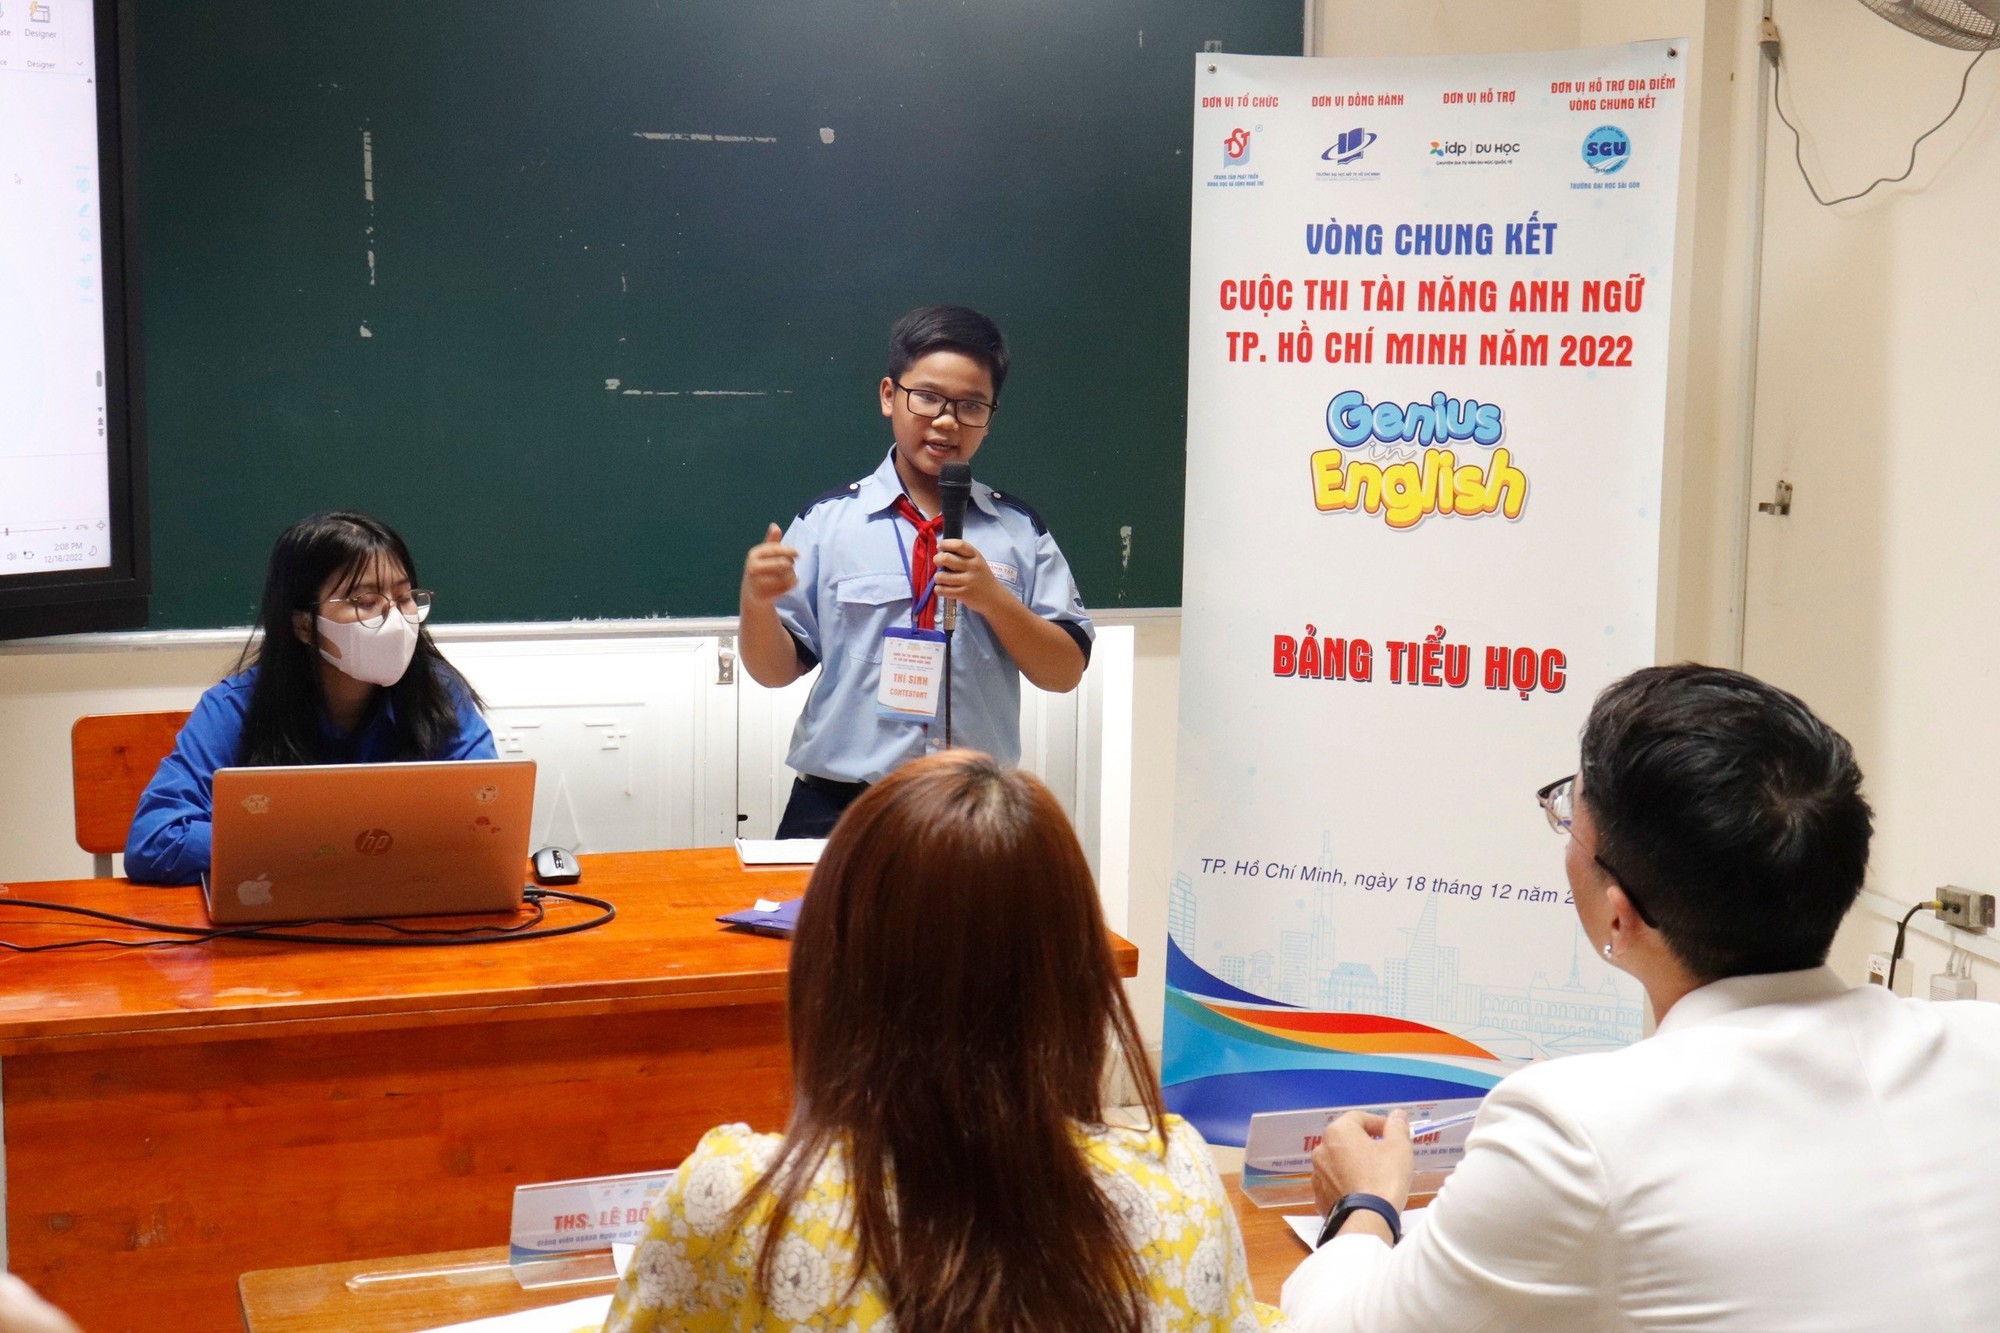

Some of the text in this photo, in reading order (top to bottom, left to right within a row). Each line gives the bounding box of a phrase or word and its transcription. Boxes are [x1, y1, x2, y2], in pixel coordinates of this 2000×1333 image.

[25, 28, 57, 39] Designer
[27, 60, 56, 70] Designer
[1551, 73, 1676, 95] ĐƠN VỊ HỖ TRỢ ĐỊA ĐIỂM
[1202, 93, 1278, 109] ĐƠN VỊ TỔ CHỨC
[1312, 91, 1404, 109] ĐƠN VỊ ĐỒNG HÀNH
[1443, 88, 1516, 106] ĐƠN VỊ HỖ TRỢ
[1570, 93, 1656, 111] VÒNG CHUNG KẾT
[1445, 141, 1467, 157] idp
[1476, 143, 1520, 156] DU HỌC
[1586, 141, 1627, 157] SGU
[1306, 211, 1557, 255] VÒNG CHUNG KẾT
[1220, 273, 1644, 317] CUỘC THI TÀI NĂNG ANH NGỮ
[1226, 320, 1632, 367] TP. HỒ CHÍ MINH NĂM 2022
[1326, 390, 1502, 447] Genius
[1368, 440, 1416, 461] in
[1310, 448, 1528, 529] English
[54, 542, 83, 552] 2:08 PM
[1274, 624, 1567, 701] BẢNG TIỂU HỌC
[908, 675, 928, 686] SINH
[890, 688, 928, 699] CONTESTANT
[360, 829, 390, 856] hp
[1201, 858, 1227, 875] TP.
[1234, 860, 1260, 877] Hồ
[1265, 863, 1295, 880] Chí
[1300, 865, 1348, 887] Minh,
[1354, 871, 1398, 893] ngày
[1405, 875, 1426, 892] 18
[1432, 877, 1482, 900] tháng
[1490, 883, 1511, 900] 12
[1518, 885, 1558, 903] năm
[553, 1212, 593, 1232] THS.
[599, 1206, 619, 1226] LÊ
